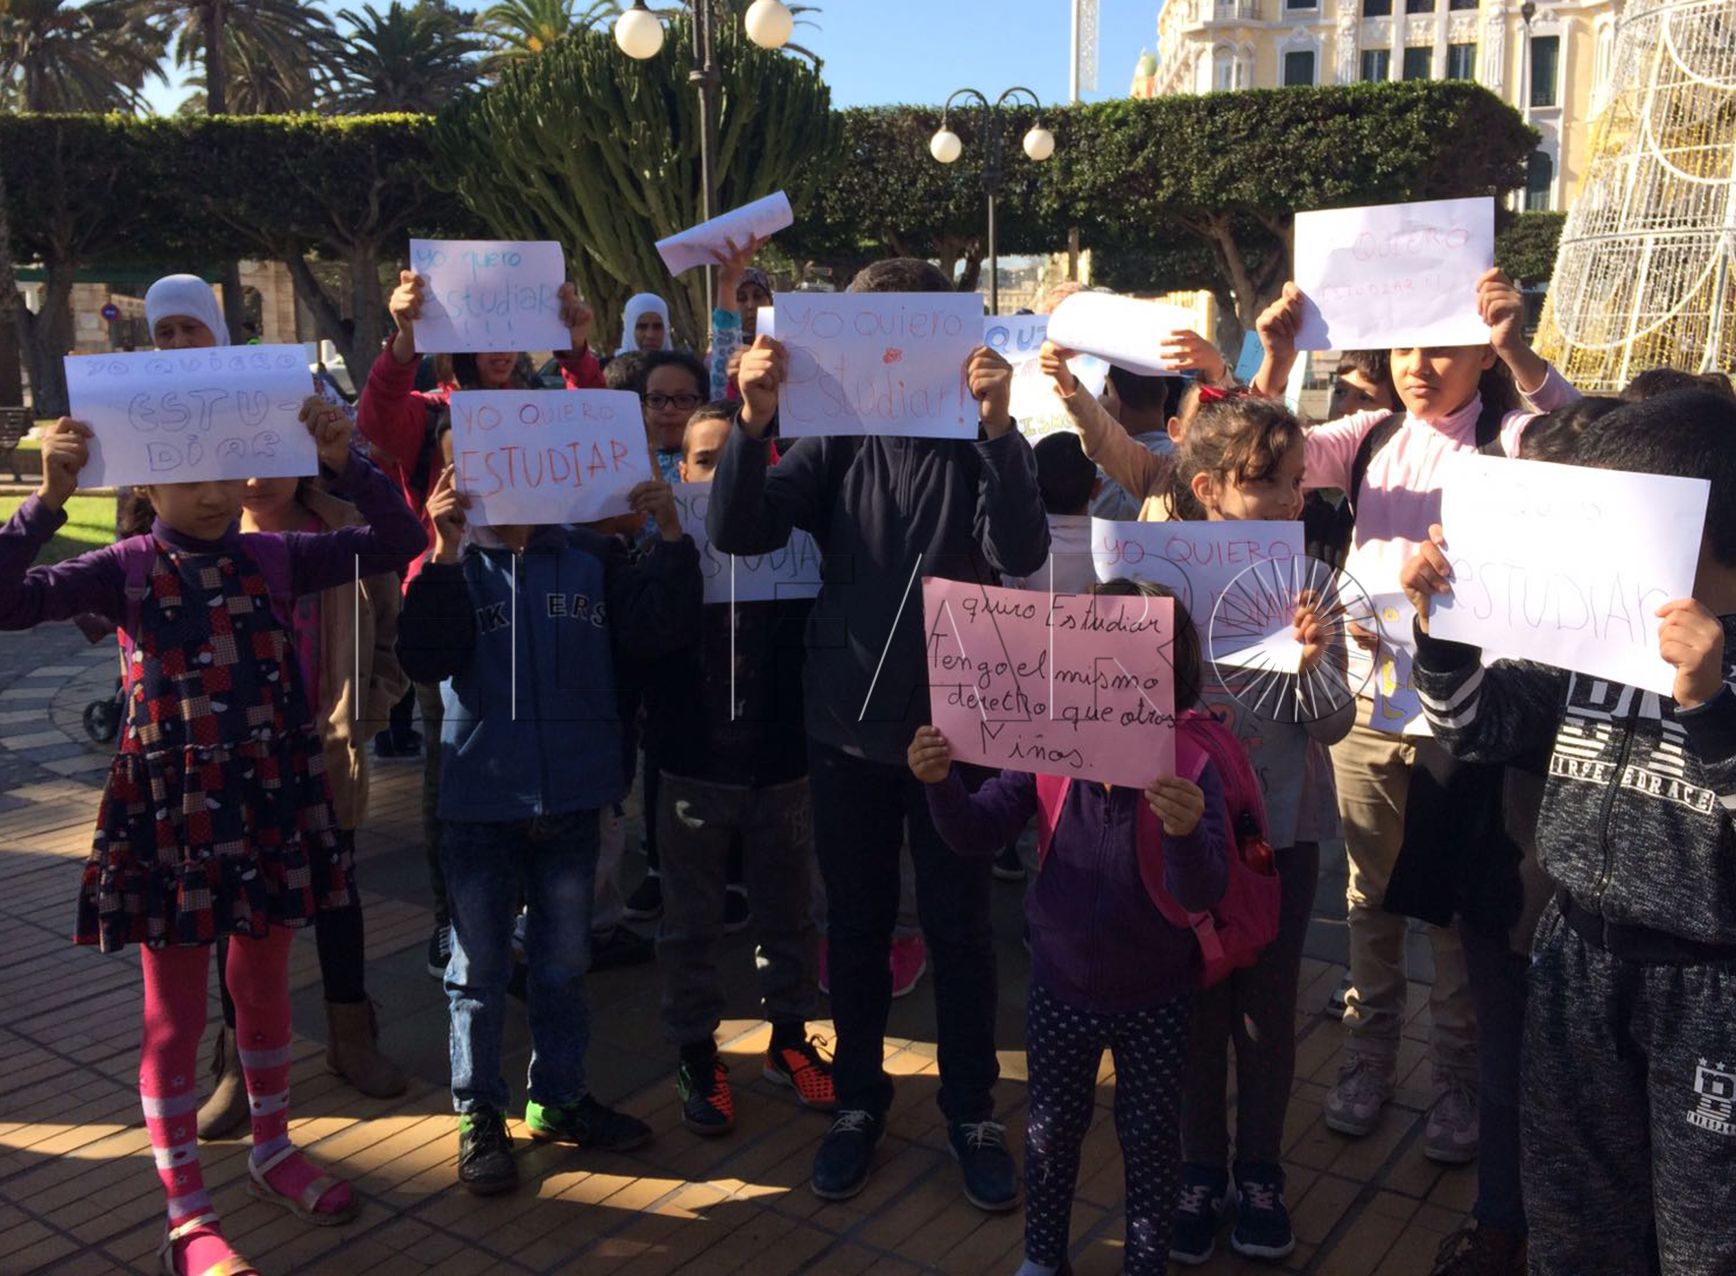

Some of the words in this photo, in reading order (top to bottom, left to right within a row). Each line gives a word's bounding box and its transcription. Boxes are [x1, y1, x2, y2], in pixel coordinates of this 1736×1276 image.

[457, 404, 503, 434] YO
[460, 437, 638, 498] ESTUDIAR
[1165, 537, 1292, 567] QUIERO
[1045, 594, 1162, 634] Estudiar
[1062, 703, 1113, 730] que
